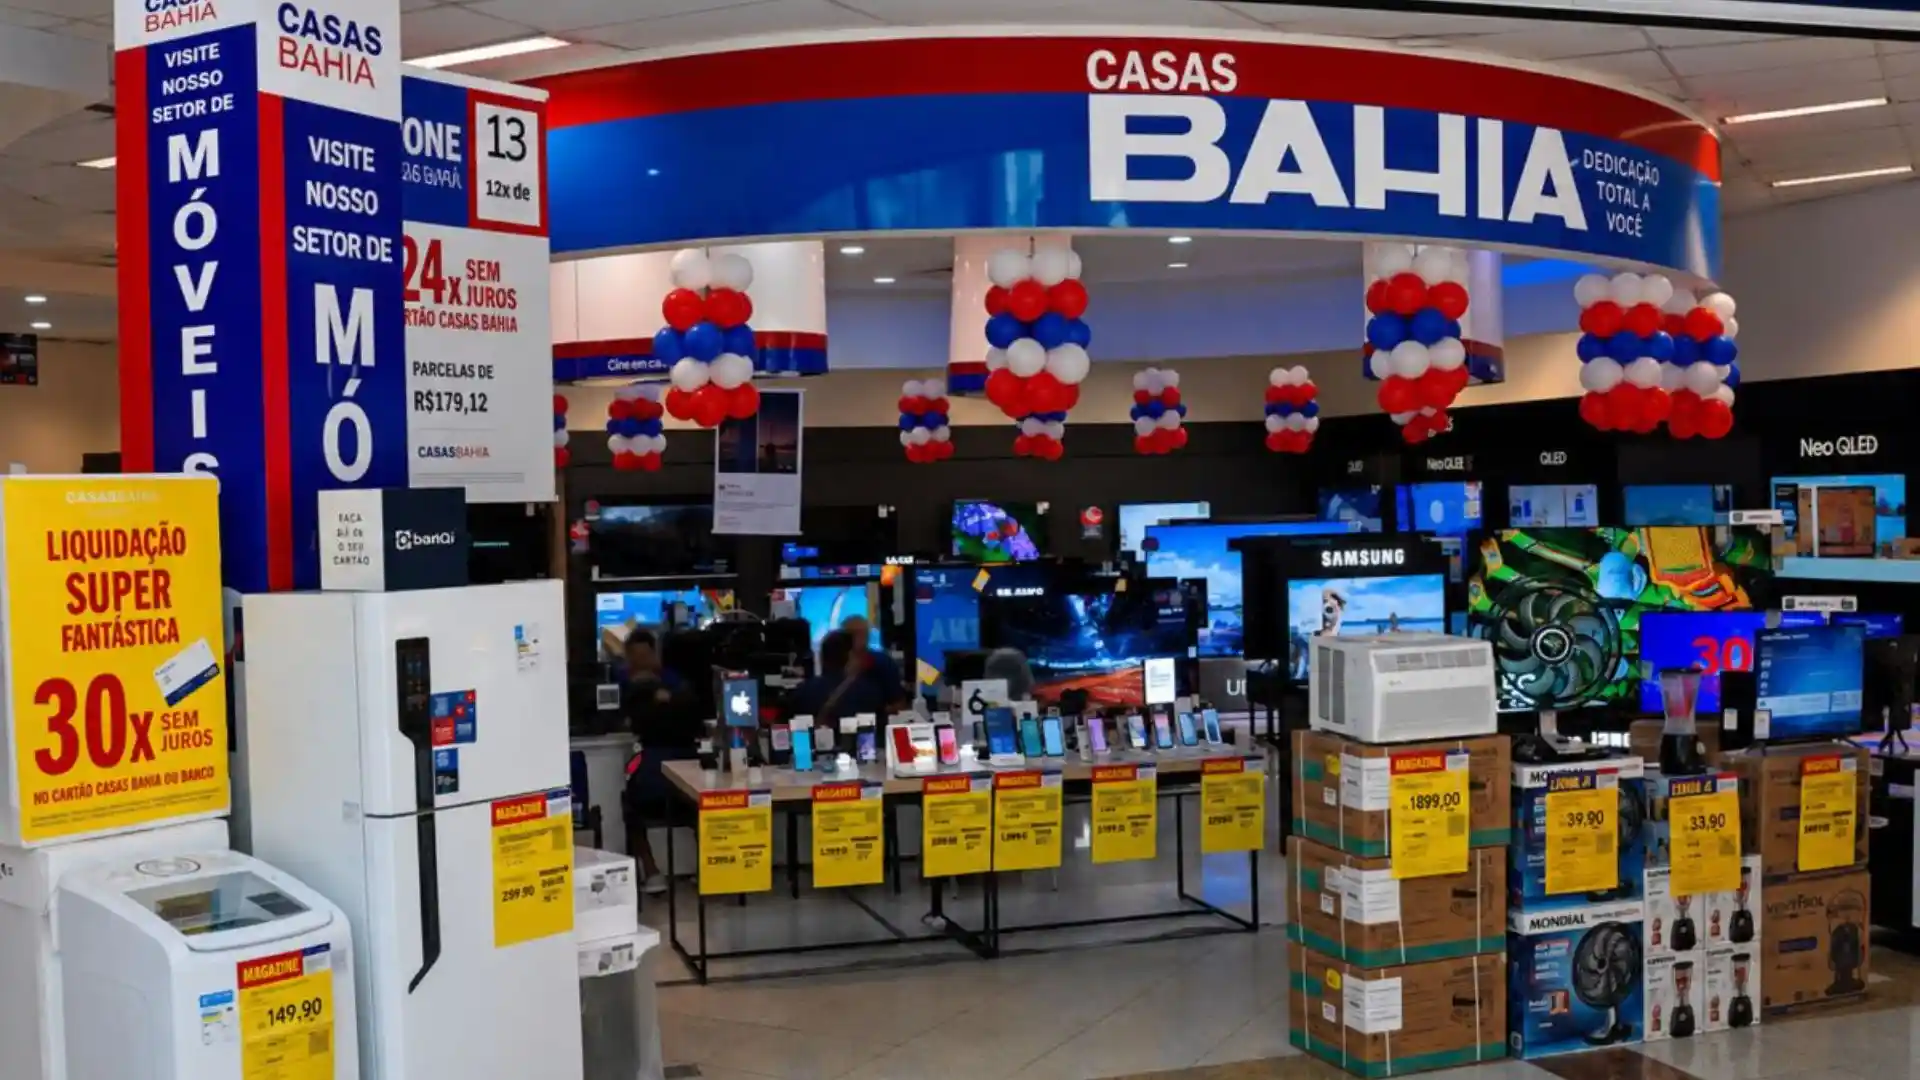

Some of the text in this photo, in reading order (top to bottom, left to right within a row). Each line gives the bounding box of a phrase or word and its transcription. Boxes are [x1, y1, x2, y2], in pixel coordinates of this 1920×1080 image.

[145, 1, 217, 32] BAHIA
[277, 2, 383, 56] CASAS
[164, 42, 221, 69] VISITE
[279, 36, 376, 89] BAHIA
[162, 69, 224, 96] NOSSO
[1086, 49, 1238, 93] CASAS
[152, 93, 235, 124] SETOR DE
[486, 114, 527, 162] 13
[308, 136, 376, 173] VISITE
[1088, 92, 1588, 231] BAHIA
[1583, 148, 1660, 187] DEDICAÇÃO
[305, 179, 379, 216] NOSSO
[486, 179, 531, 201] 12x de
[1597, 180, 1651, 212] TOTAL A
[1606, 209, 1643, 238] VOCÊ
[293, 226, 393, 262] SETOR DE
[465, 258, 501, 282] SEM
[465, 285, 518, 310] JUROS
[439, 310, 479, 332] CASAS
[482, 315, 519, 334] BAHIA
[412, 361, 495, 380] PARCELAS DE
[413, 390, 488, 415] R$179,12
[1800, 434, 1879, 458] Neo QLED
[46, 520, 188, 565] LIQUIDAÇÃO
[1321, 548, 1406, 567] SAMSUNG
[65, 568, 173, 616] SUPER
[61, 613, 180, 653] FANTÁSTICA
[33, 672, 157, 776] 30x
[160, 709, 200, 731] SEM
[160, 728, 214, 753] JUROS
[52, 781, 94, 803] CARTÃO
[96, 777, 129, 797] CASAS
[1410, 791, 1460, 811] 1899,00
[267, 997, 322, 1027] 149,90
